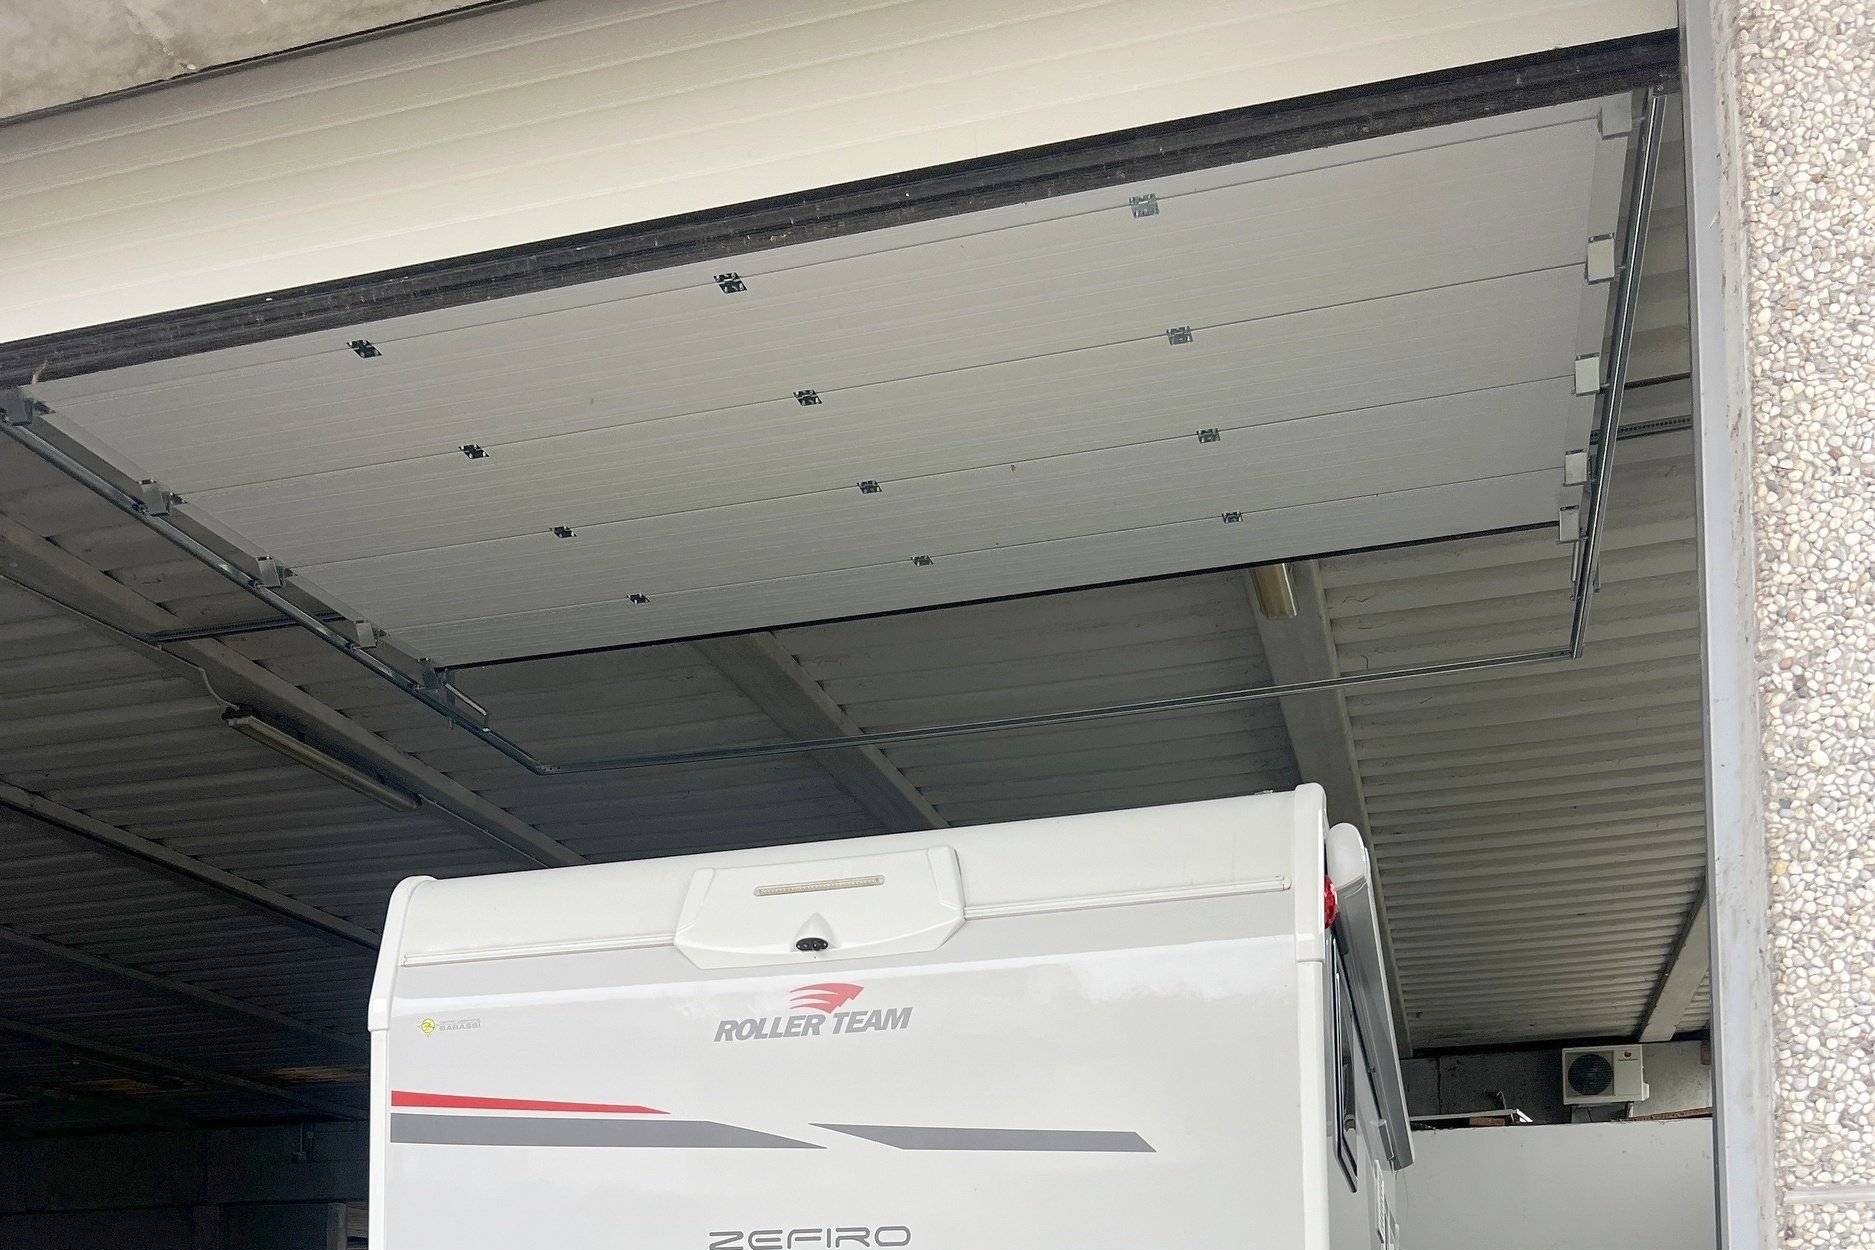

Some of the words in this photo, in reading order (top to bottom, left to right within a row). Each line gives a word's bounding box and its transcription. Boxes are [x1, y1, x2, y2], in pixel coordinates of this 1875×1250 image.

[714, 1014, 826, 1042] ROLLER
[832, 1007, 913, 1034] TEAM
[709, 1225, 911, 1250] ZEFIRO
